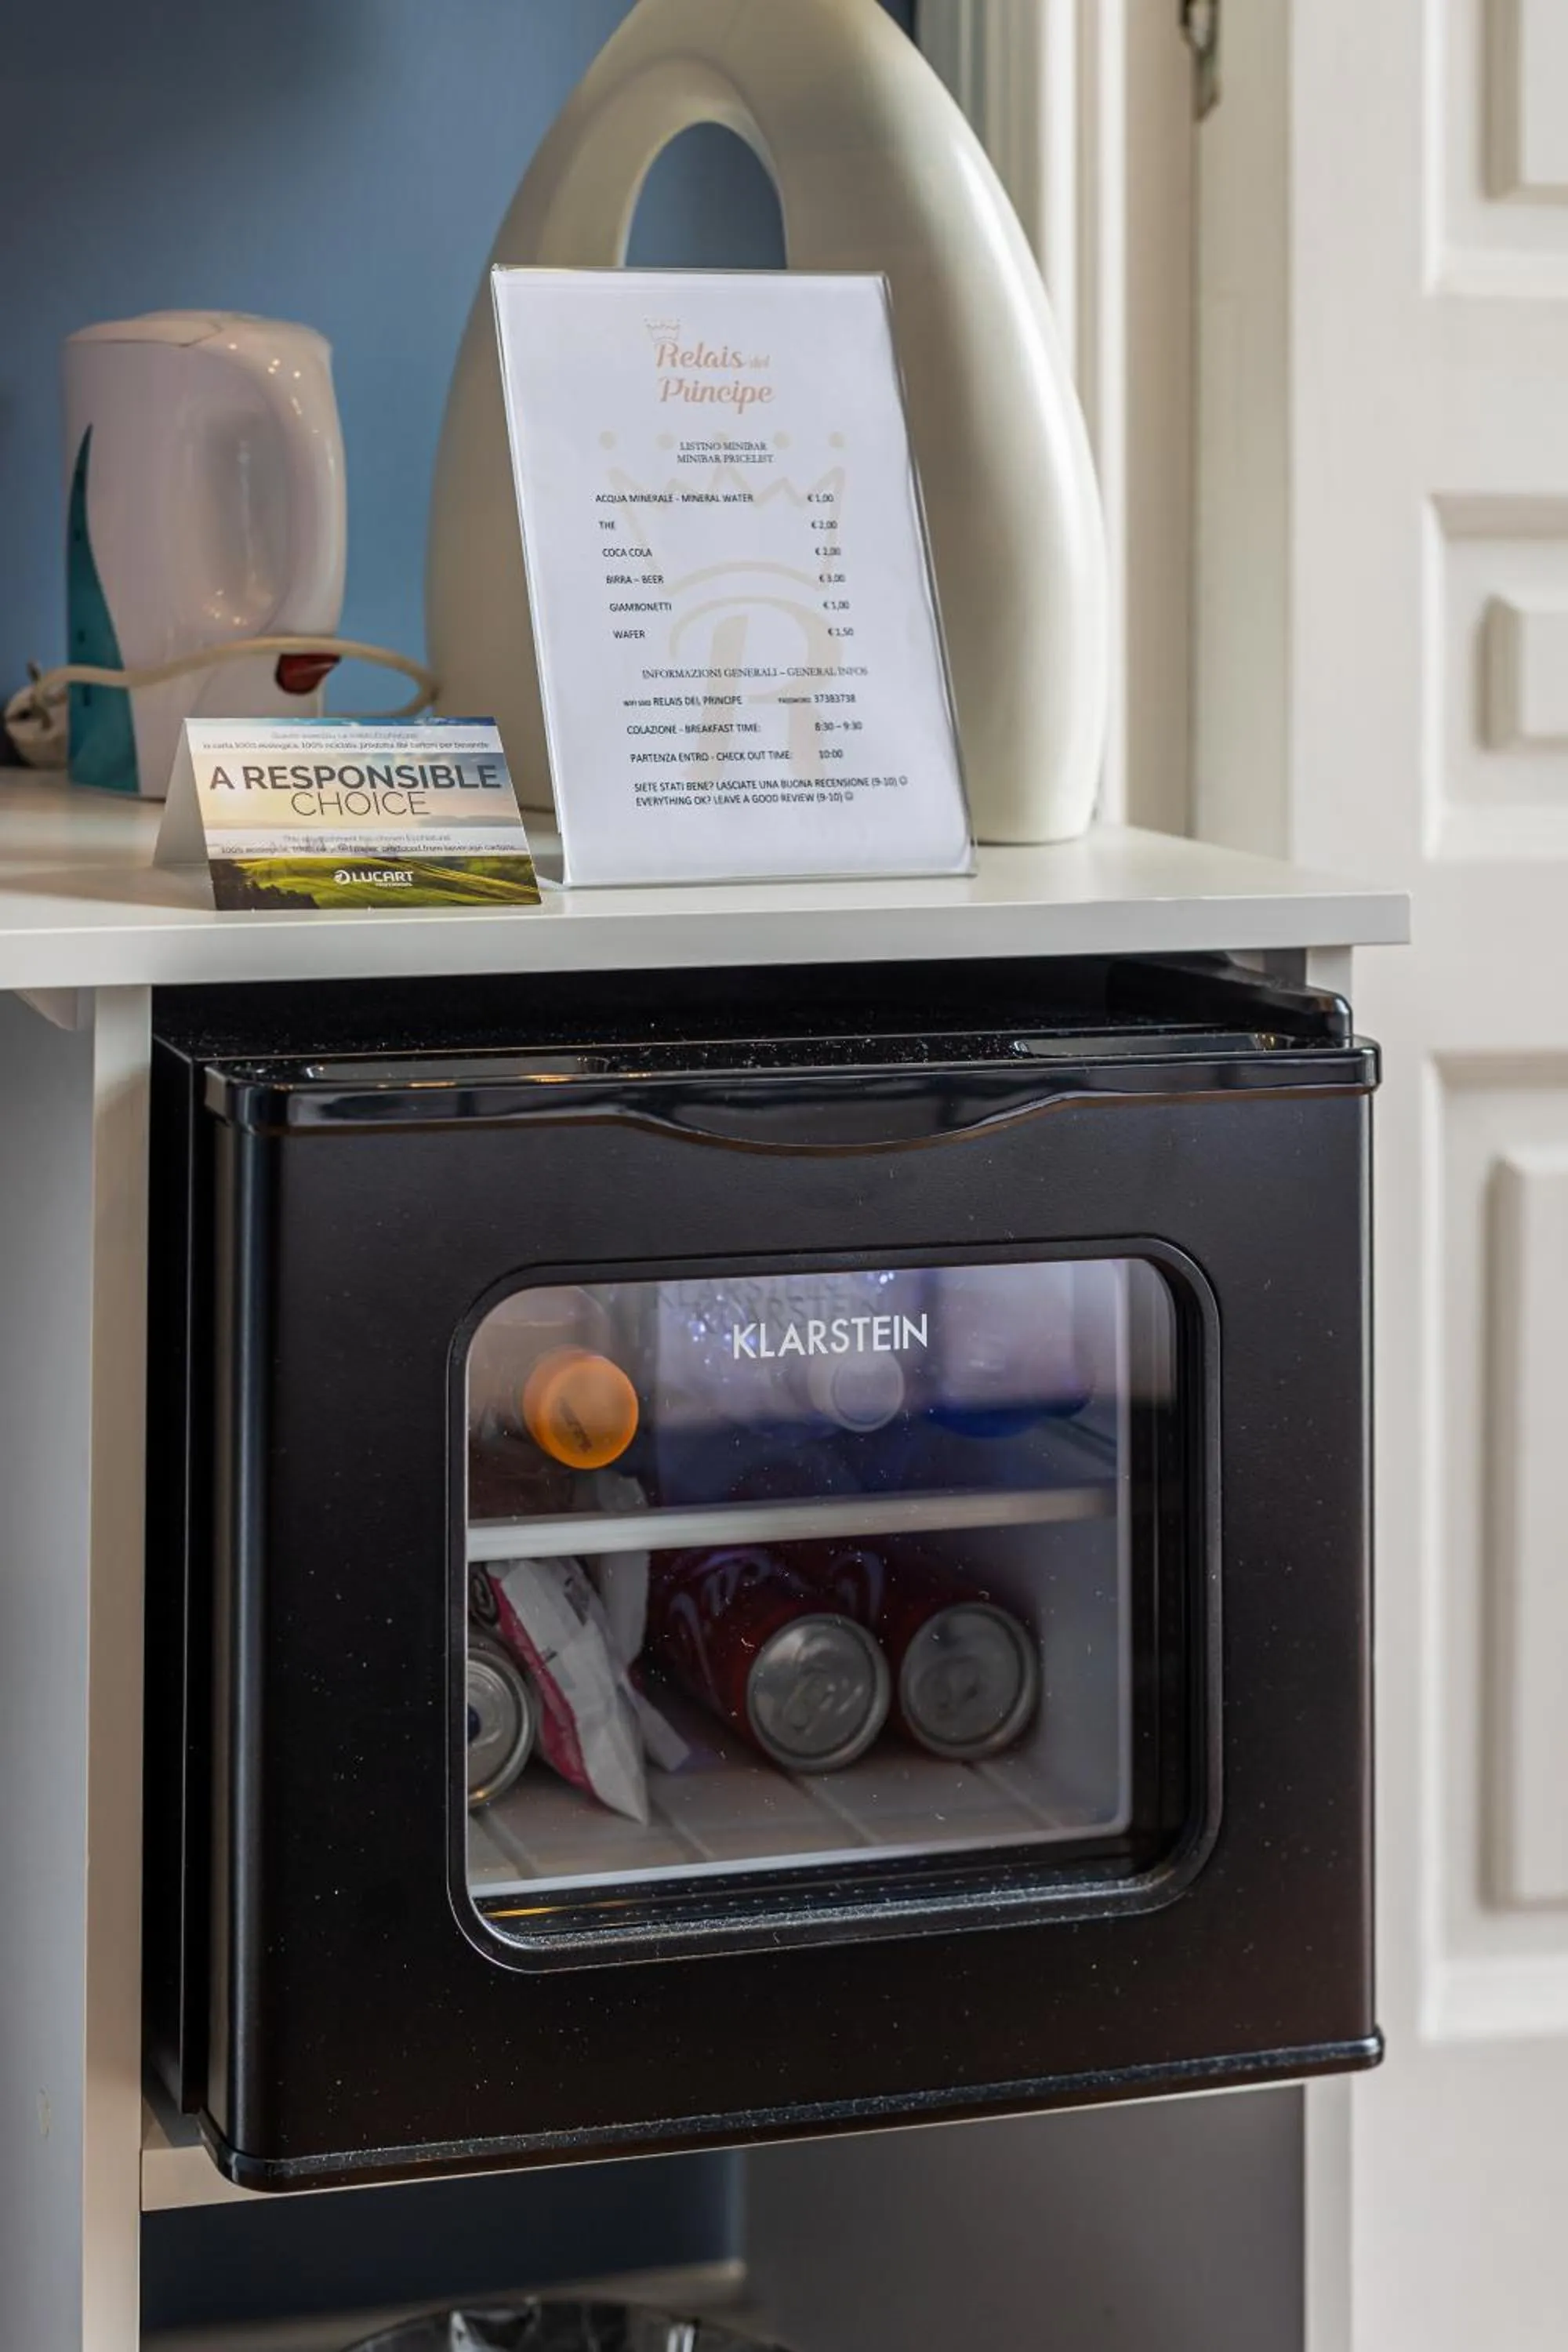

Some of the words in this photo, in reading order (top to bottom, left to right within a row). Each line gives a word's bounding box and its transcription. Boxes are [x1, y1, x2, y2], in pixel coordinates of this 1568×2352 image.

[659, 376, 775, 415] Principe
[680, 441, 721, 450] LISTINO
[724, 441, 767, 450] MINIBAR
[677, 454, 721, 463] MINIBAR
[595, 494, 627, 503] ACQUA
[629, 494, 673, 503] MINERALE
[681, 494, 720, 503] MINERAL
[722, 494, 753, 503] WATER
[598, 521, 615, 530] THE
[602, 548, 627, 557] COCA
[628, 548, 653, 557] COLA
[606, 575, 632, 584] BIRRA
[642, 575, 664, 584] BEER
[608, 602, 672, 612] GIAMBONETTI
[613, 630, 646, 639] WAFER
[641, 669, 722, 679] INFORMAZIONI
[724, 667, 778, 677] GENERALI
[786, 667, 836, 677] GENERAL
[653, 696, 683, 706] RELAIS
[684, 696, 702, 706] DEL
[703, 695, 743, 706] PRINCIPE
[626, 724, 677, 735] COLAZIONE
[684, 724, 733, 734] BREAKFAST
[630, 753, 677, 763] PARTENZA
[678, 753, 709, 761] ENTRO
[716, 752, 745, 761] CHECK
[747, 750, 766, 760] OUT
[211, 766, 235, 789] A
[241, 764, 502, 790] RESPONSIBLE
[634, 782, 658, 793] SIETE
[659, 782, 684, 792] STATI
[716, 780, 757, 790] LASCIATE
[760, 779, 779, 789] UNA
[780, 779, 813, 788] BUONA
[815, 777, 869, 788] RECENSIONE
[291, 791, 430, 816] CHOICE
[636, 796, 692, 807] EVERYTHING
[713, 794, 741, 805] LEAVE
[742, 794, 750, 804] A
[752, 793, 779, 804] GOOD
[780, 793, 815, 802] REVIEW
[351, 871, 414, 882] LUCART
[733, 1313, 928, 1359] KLARSTEIN
